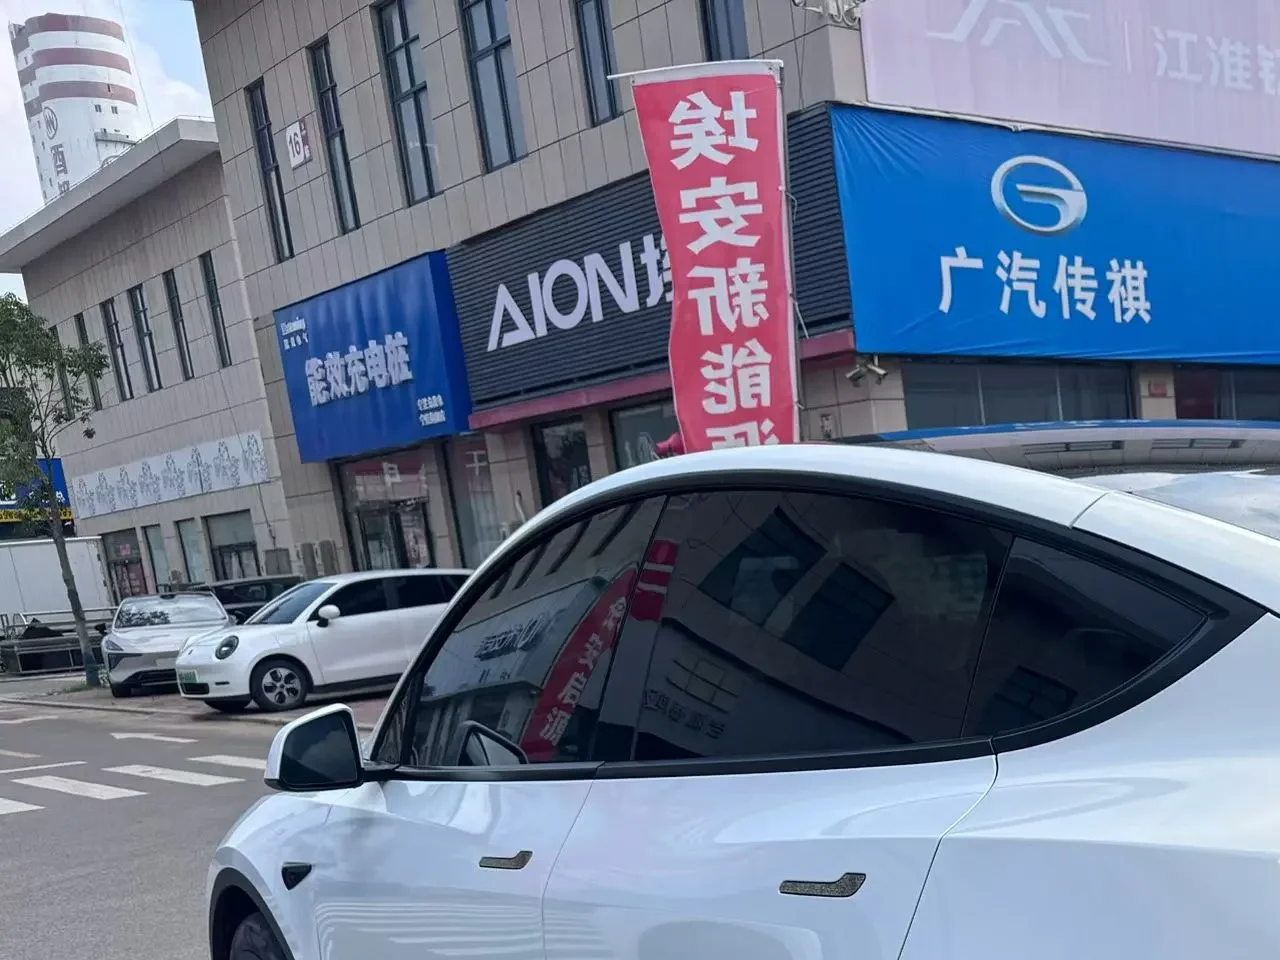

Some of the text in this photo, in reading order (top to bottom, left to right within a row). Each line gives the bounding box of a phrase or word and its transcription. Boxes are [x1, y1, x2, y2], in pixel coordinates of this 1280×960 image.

[938, 246, 1151, 325] 广汽传祺
[305, 331, 414, 408] 能效充电桩
